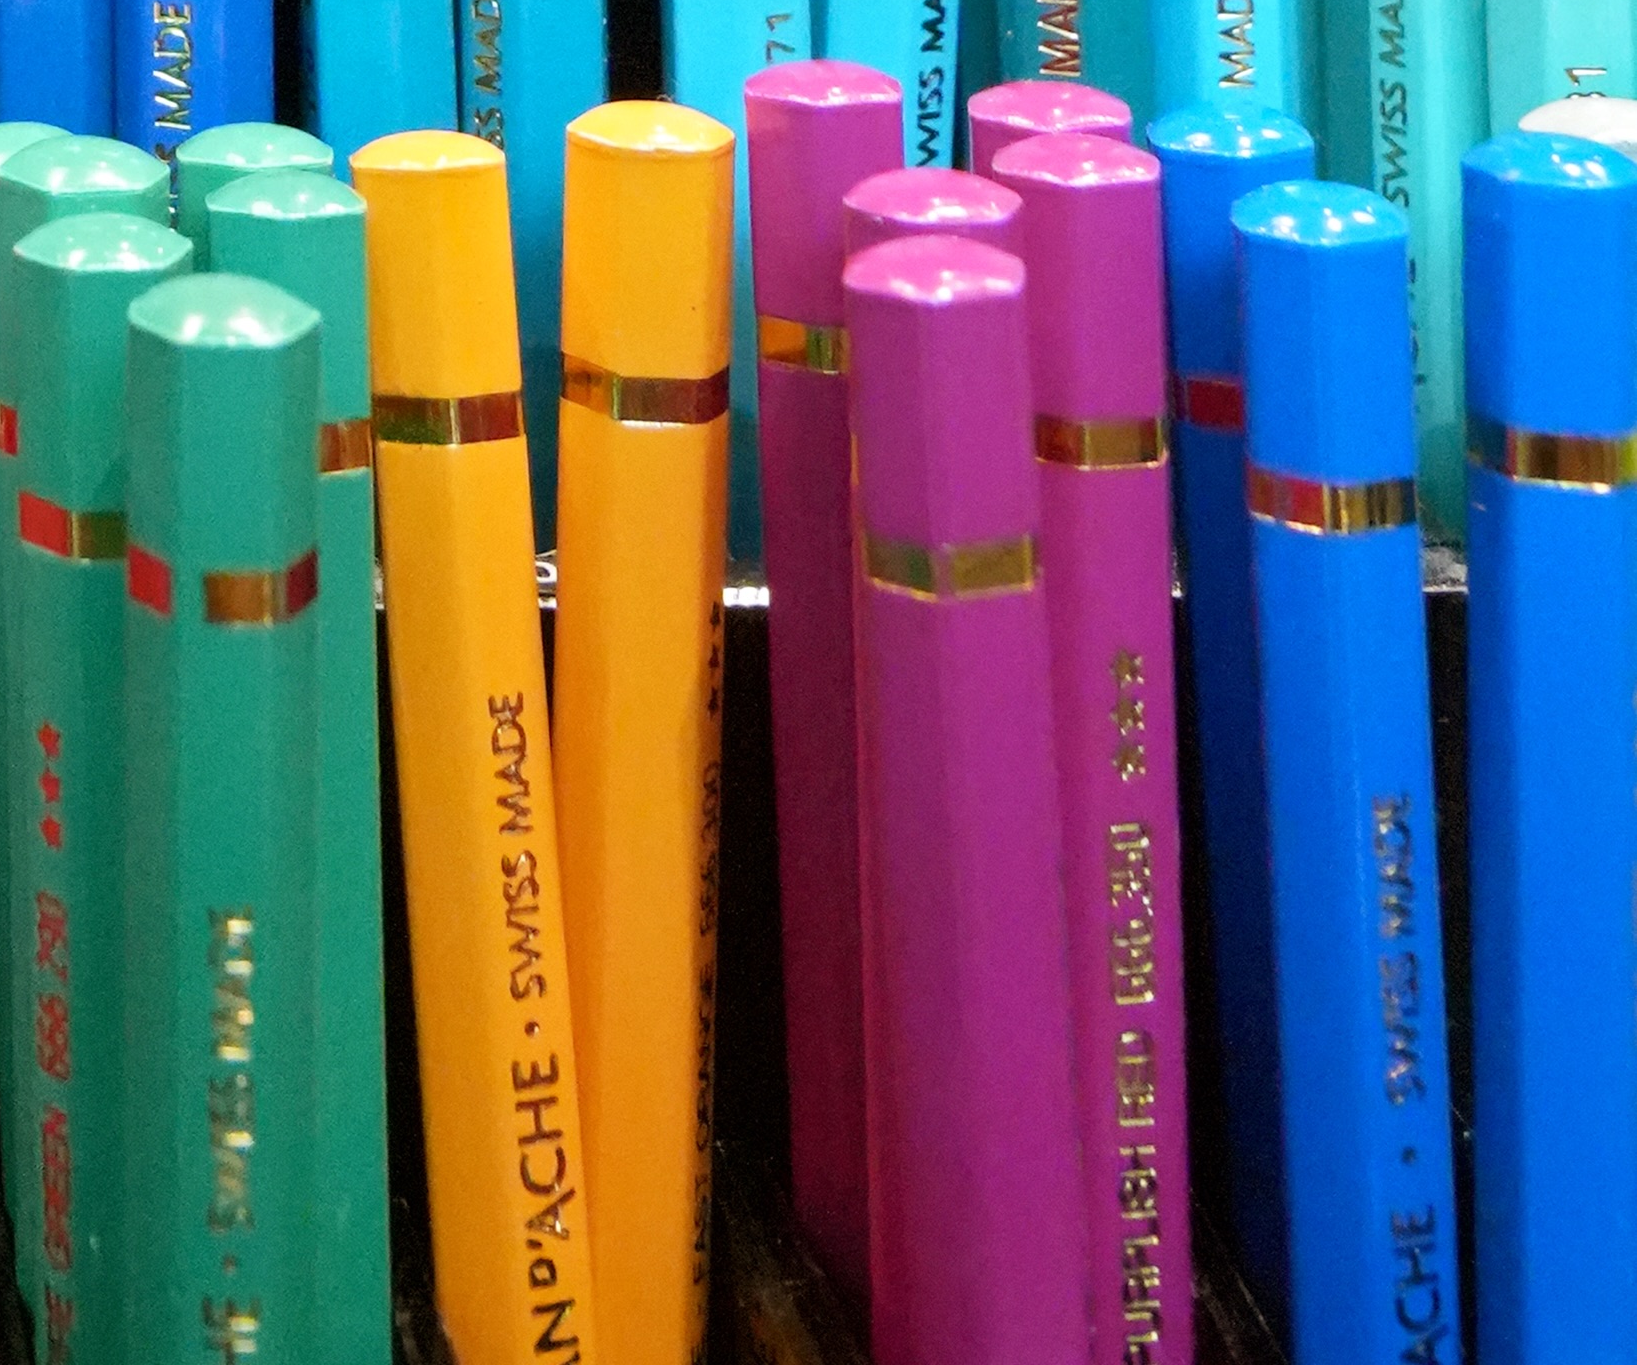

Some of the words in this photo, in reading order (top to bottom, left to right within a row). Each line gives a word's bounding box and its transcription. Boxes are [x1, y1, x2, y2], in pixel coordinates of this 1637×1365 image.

[152, 0, 194, 131] MADE
[1376, 76, 1411, 209] SWISS
[487, 690, 538, 836] MADE
[501, 849, 548, 1004] SWISS
[1371, 792, 1417, 938] MADE
[206, 907, 255, 1064] MADE
[1378, 951, 1427, 1107] SWISS
[206, 1073, 256, 1235] SWISS
[1115, 1030, 1156, 1128] RED
[510, 1051, 576, 1288] D'ACHE
